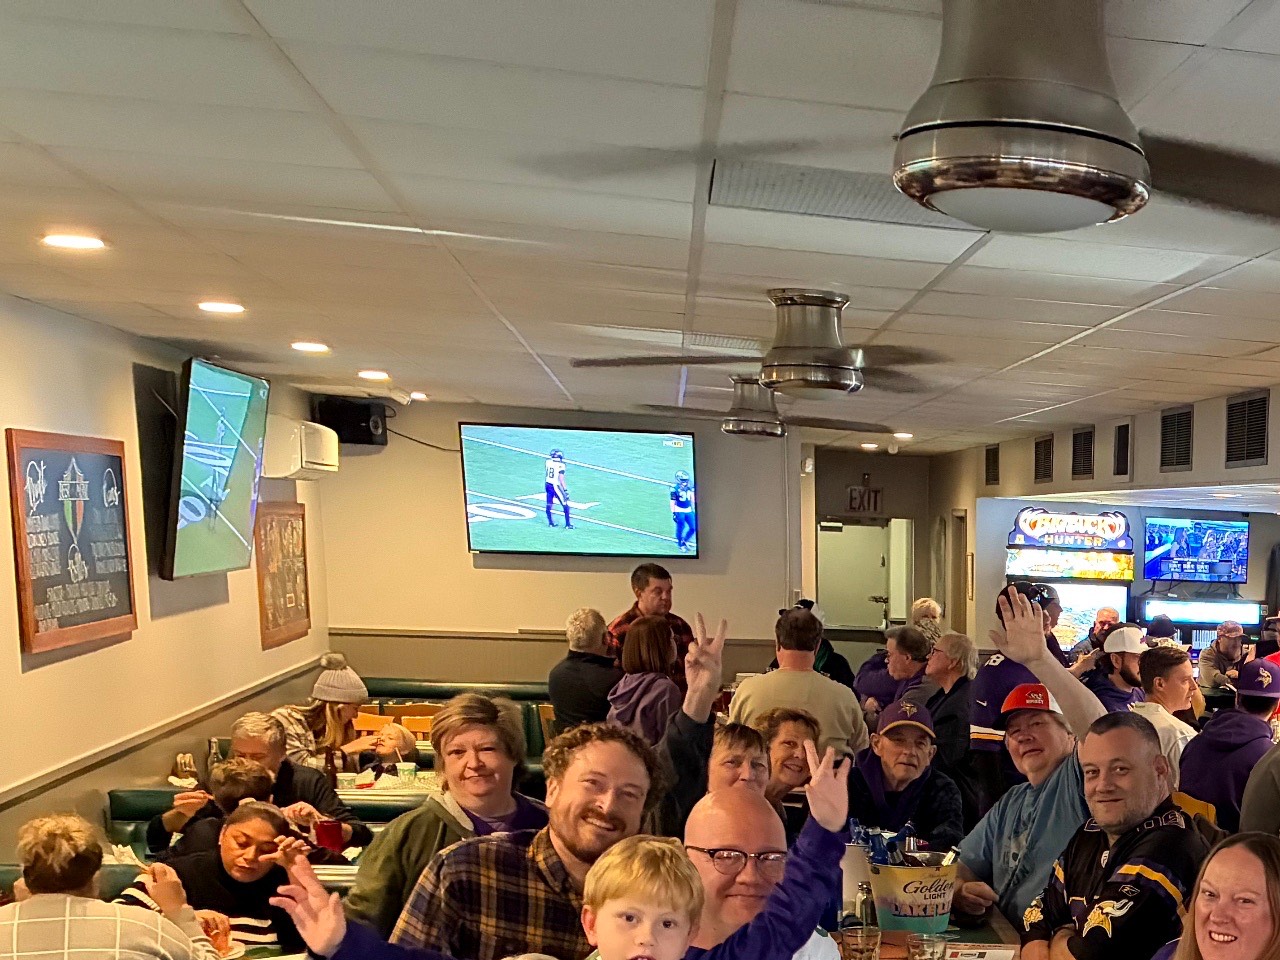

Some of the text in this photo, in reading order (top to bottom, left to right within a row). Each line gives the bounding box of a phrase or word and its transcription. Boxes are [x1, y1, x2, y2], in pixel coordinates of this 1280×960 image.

[849, 488, 881, 511] EXIT
[1044, 534, 1103, 547] HUNTER
[903, 878, 955, 894] Golden
[923, 892, 947, 900] LIGHT
